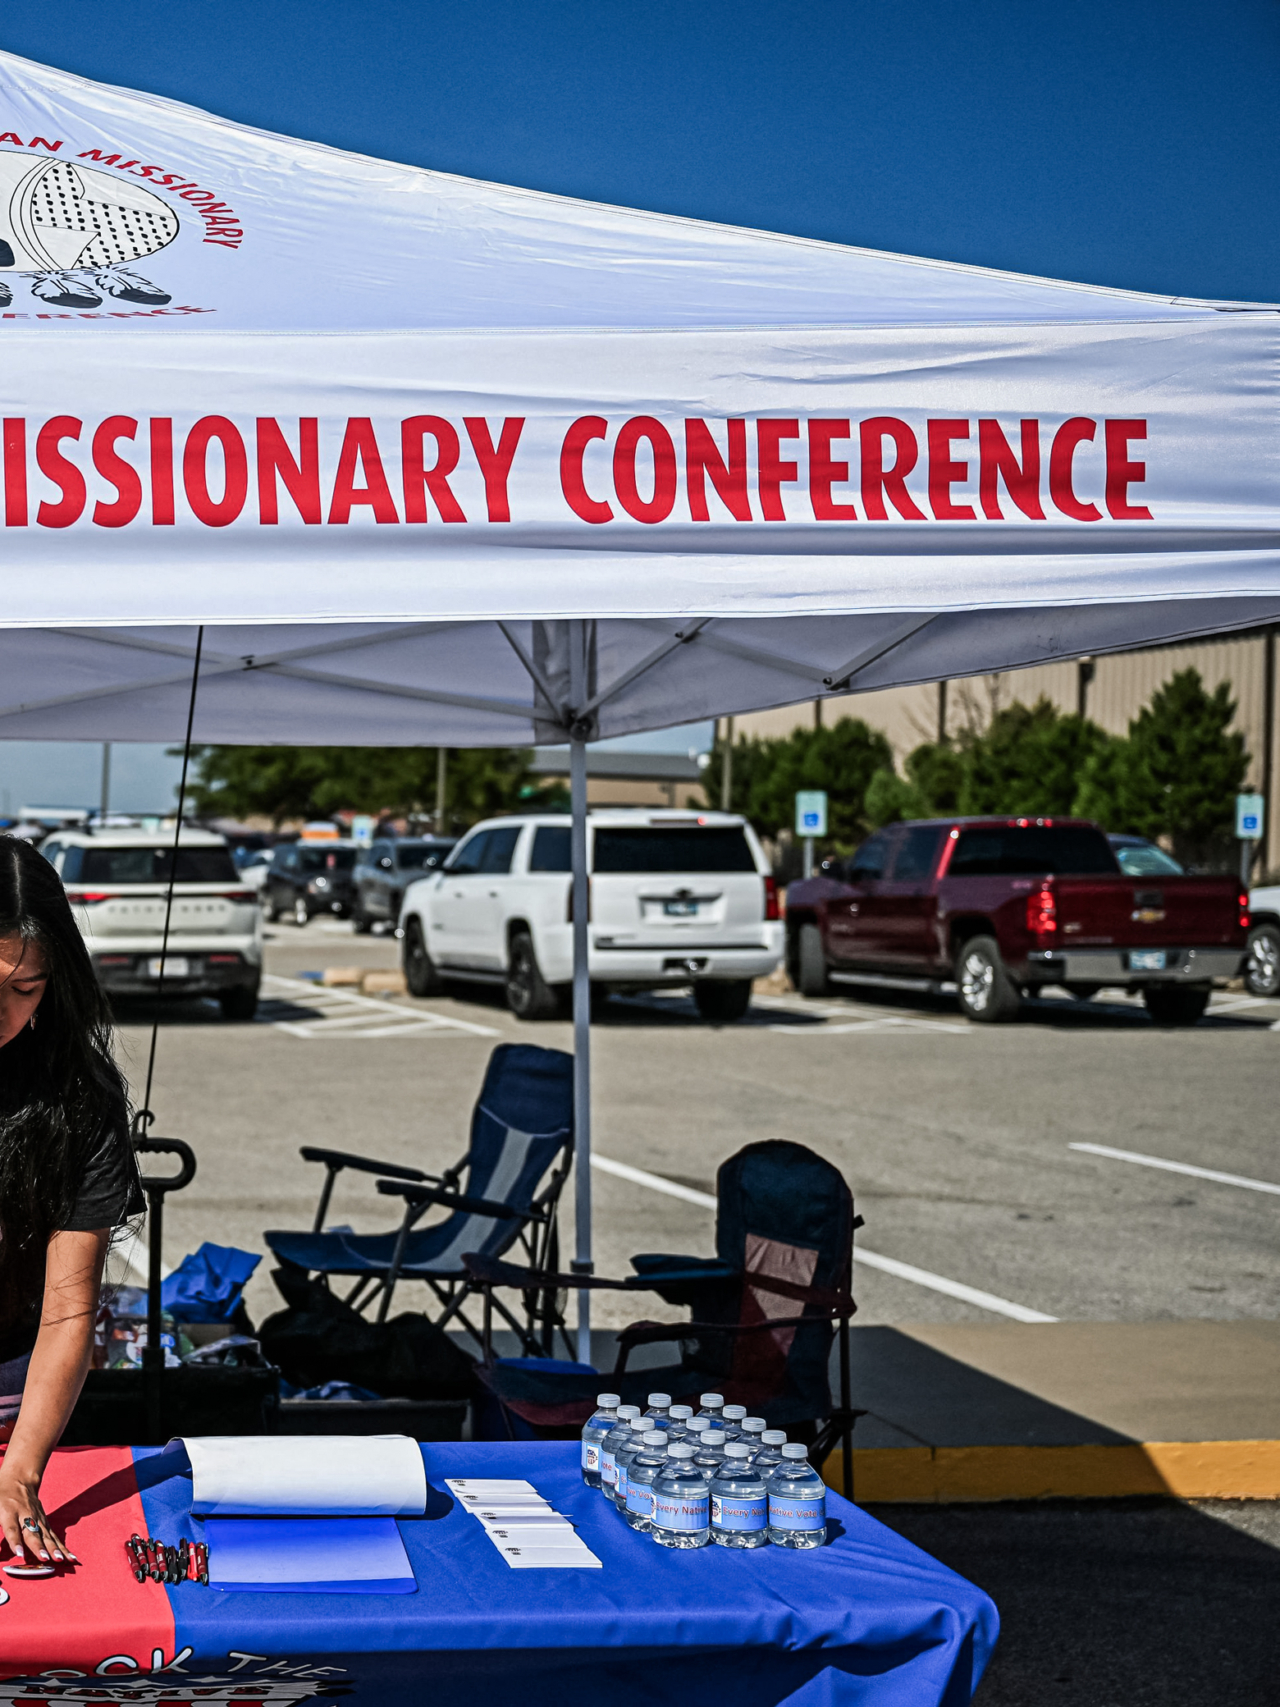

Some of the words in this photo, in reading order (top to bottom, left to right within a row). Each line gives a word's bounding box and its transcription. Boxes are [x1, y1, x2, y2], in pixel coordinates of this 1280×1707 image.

[78, 149, 245, 251] MISSIONARY
[560, 416, 1153, 523] CONFERENCE
[656, 1501, 679, 1516] Every
[723, 1505, 750, 1518] Every
[795, 1508, 817, 1519] Vote
[36, 1647, 193, 1677] OCK
[227, 1651, 348, 1678] THE
